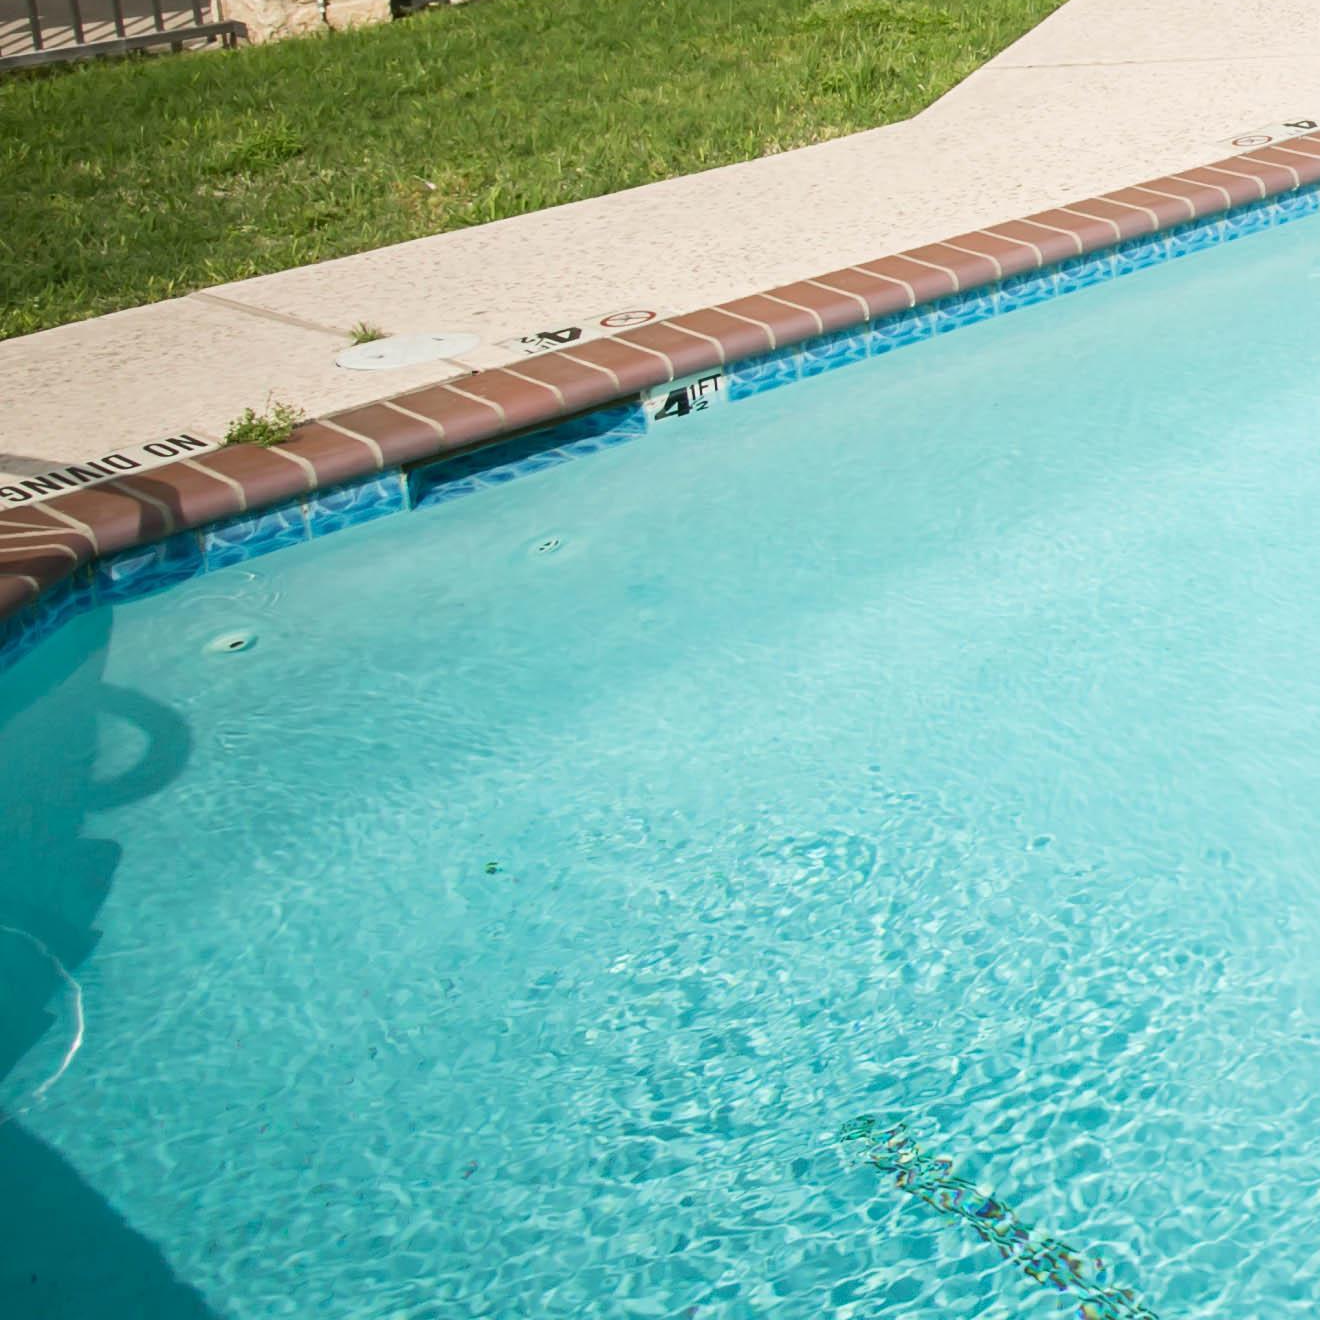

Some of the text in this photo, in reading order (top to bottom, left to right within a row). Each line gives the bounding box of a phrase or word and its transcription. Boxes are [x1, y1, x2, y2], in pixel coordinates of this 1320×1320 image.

[536, 327, 582, 343] 4
[655, 386, 690, 421] 4
[0, 433, 209, 502] NO DIVING
